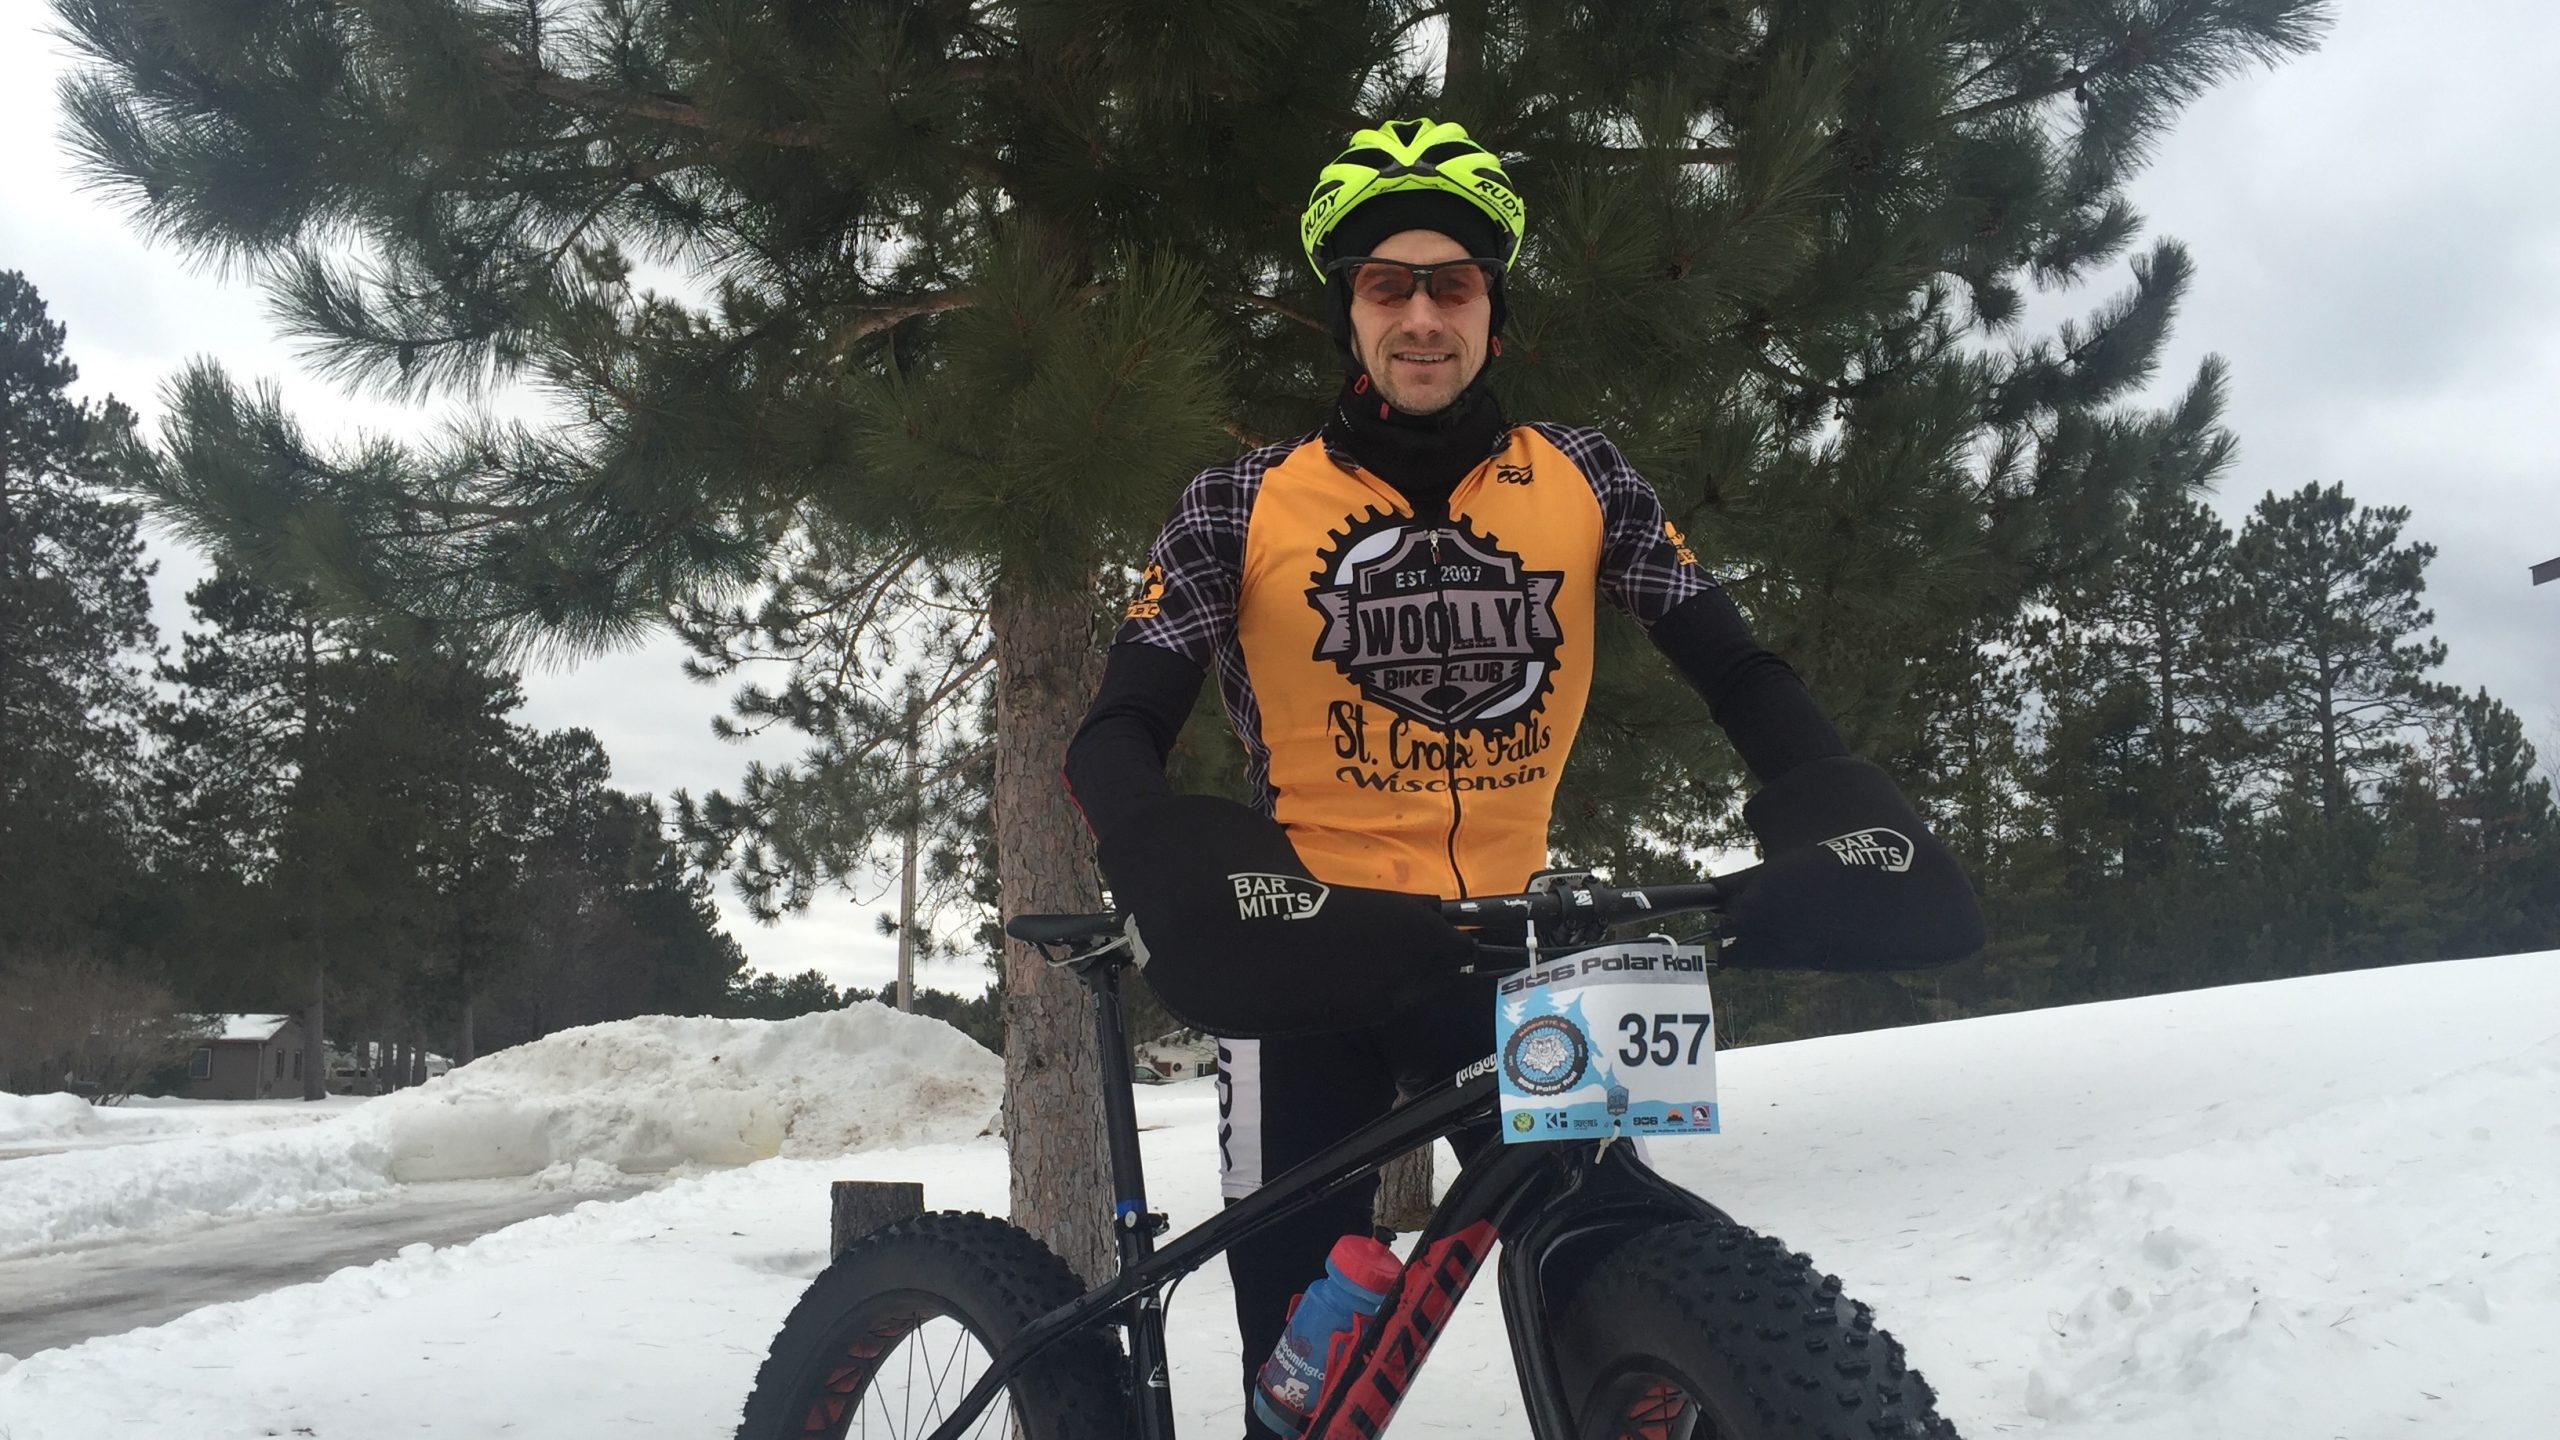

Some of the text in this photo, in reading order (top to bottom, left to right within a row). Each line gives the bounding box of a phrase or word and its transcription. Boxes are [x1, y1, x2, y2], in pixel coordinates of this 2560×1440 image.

[1474, 180, 1522, 218] RUDY
[1304, 188, 1341, 241] RUDY
[1395, 565, 1482, 588] EST. 2007
[1358, 597, 1523, 656] WOOLLY
[1383, 662, 1503, 690] BIKE CLUB
[1326, 700, 1379, 766] St.
[1487, 718, 1552, 767] Falls
[1336, 765, 1550, 793] Wisconsin
[1825, 833, 1879, 852] BAR
[1836, 846, 1904, 866] MITTS
[1234, 876, 1289, 899] BAR
[1238, 892, 1314, 921] MITTS
[1500, 963, 1576, 996] 906
[1582, 953, 1659, 975] Polar
[1662, 953, 1704, 972] Roll
[1618, 1013, 1711, 1068] 357
